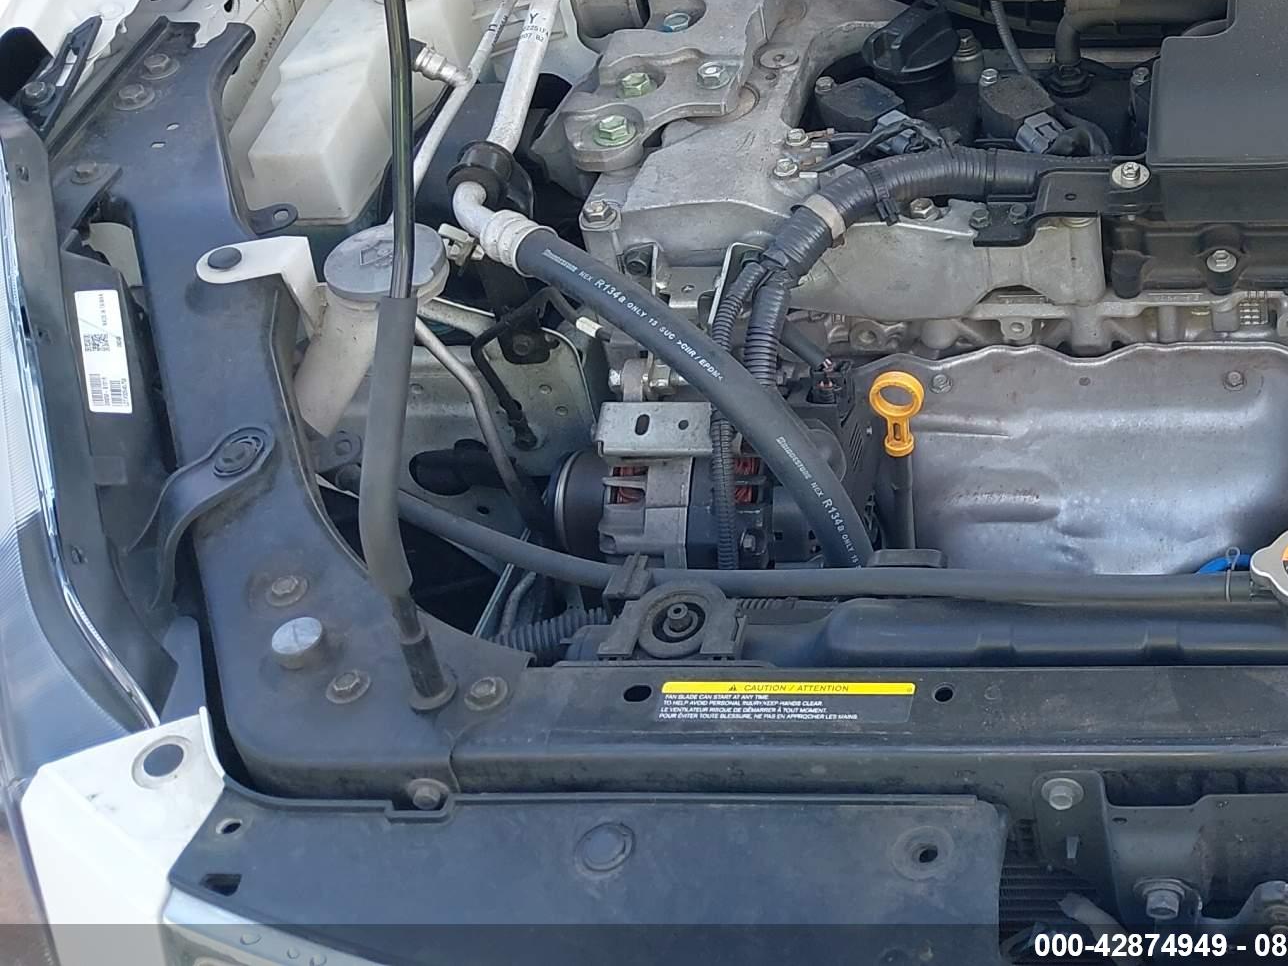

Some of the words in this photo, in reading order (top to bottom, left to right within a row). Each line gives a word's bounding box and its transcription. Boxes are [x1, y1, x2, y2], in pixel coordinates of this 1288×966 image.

[529, 12, 539, 24] Y
[594, 278, 626, 304] R134a
[626, 301, 648, 318] ONLY
[821, 497, 845, 533] R134a
[841, 533, 856, 553] ONLY
[743, 684, 787, 692] CAUTION
[797, 684, 850, 693] ATTENTION
